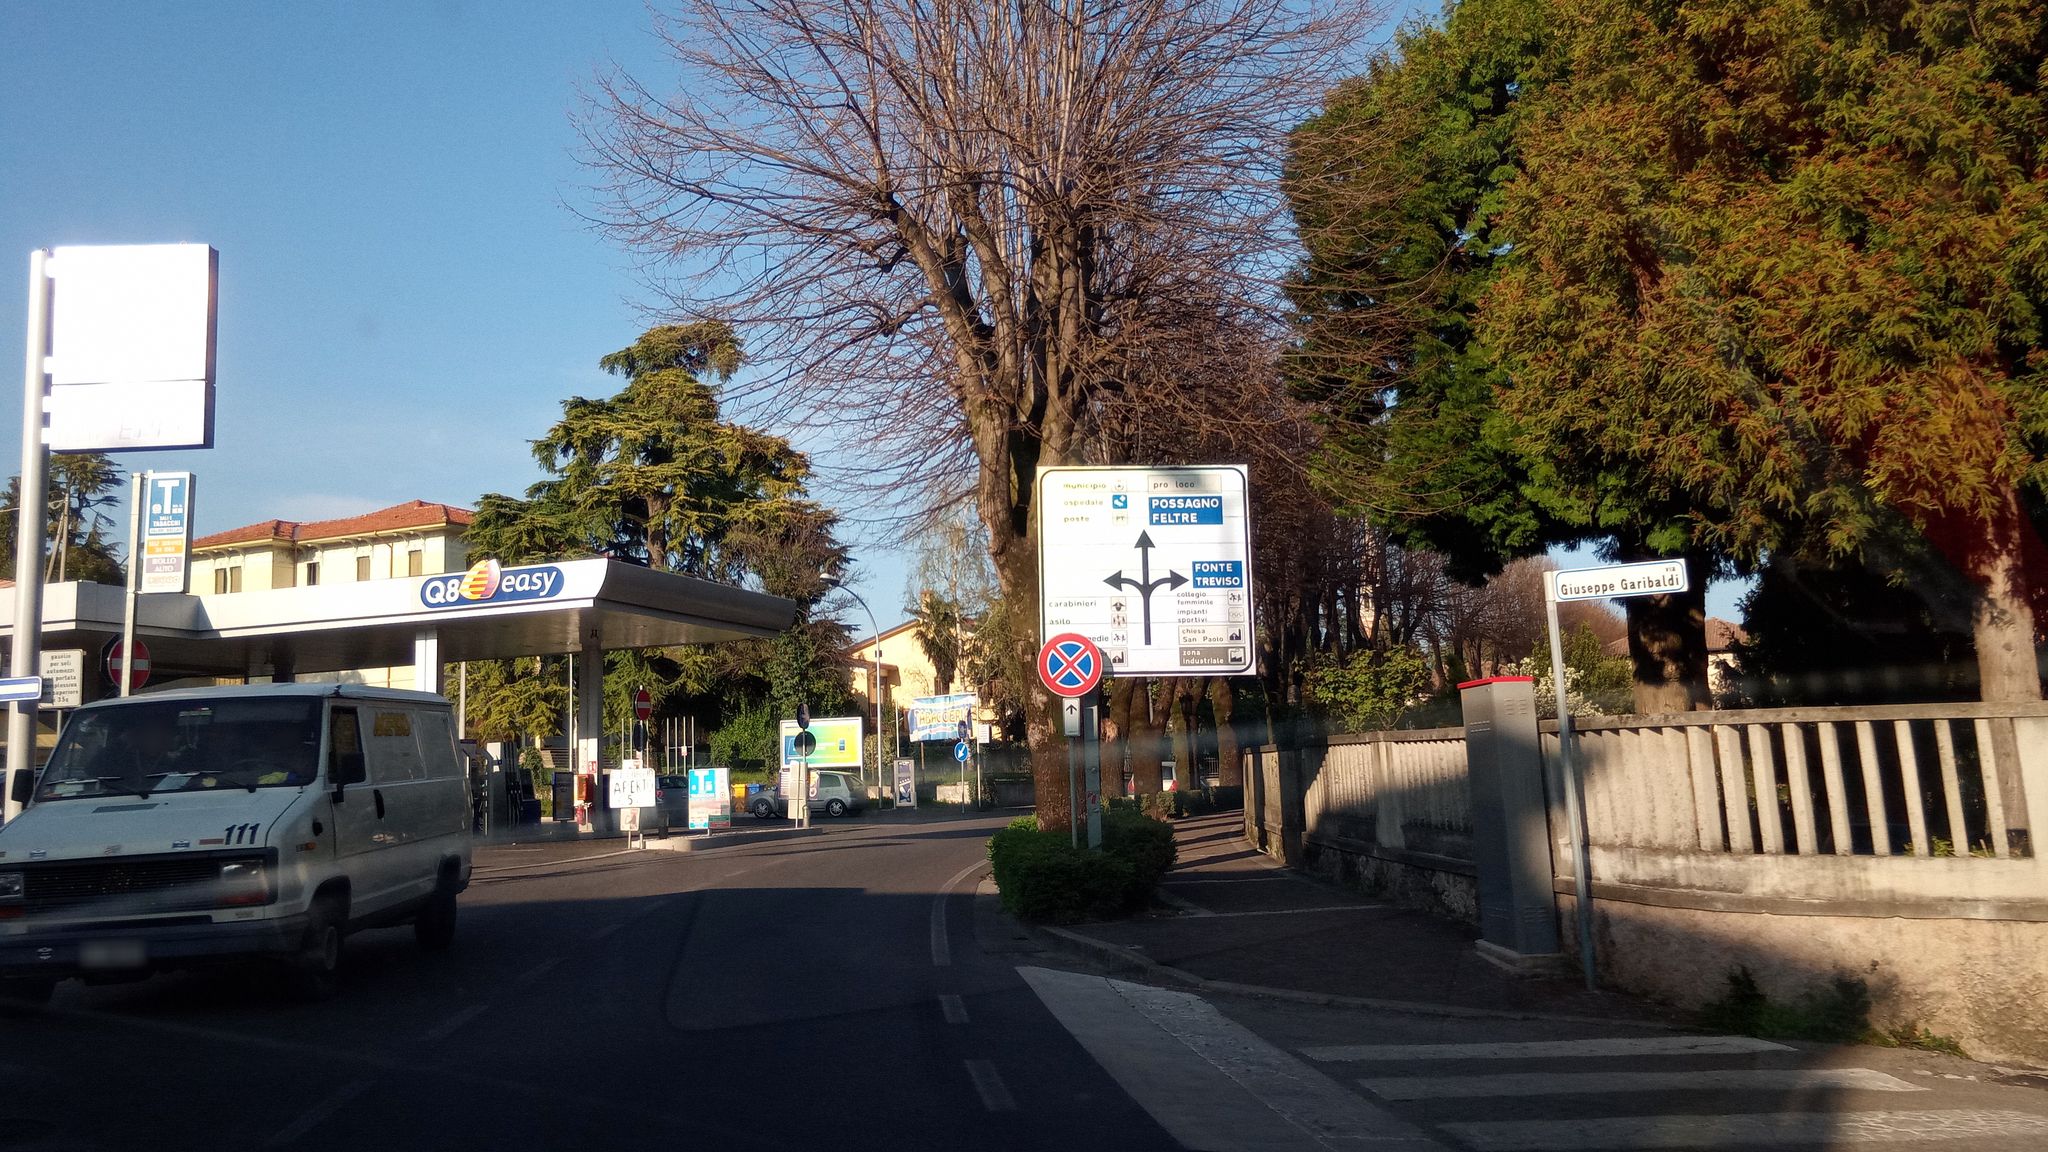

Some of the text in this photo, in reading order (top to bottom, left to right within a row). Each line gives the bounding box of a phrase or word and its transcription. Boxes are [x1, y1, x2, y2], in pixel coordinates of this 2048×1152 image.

[1153, 482, 1169, 490] pro
[158, 480, 179, 514] T
[1152, 498, 1219, 509] POSSAGNO
[1152, 513, 1198, 523] FELTRE
[1195, 563, 1233, 572] FONTE
[1195, 577, 1240, 586] TREVISO
[1561, 574, 1680, 595] Giuseppe Garibaldi
[426, 571, 557, 604] Q8 easy
[225, 822, 261, 846] 111
